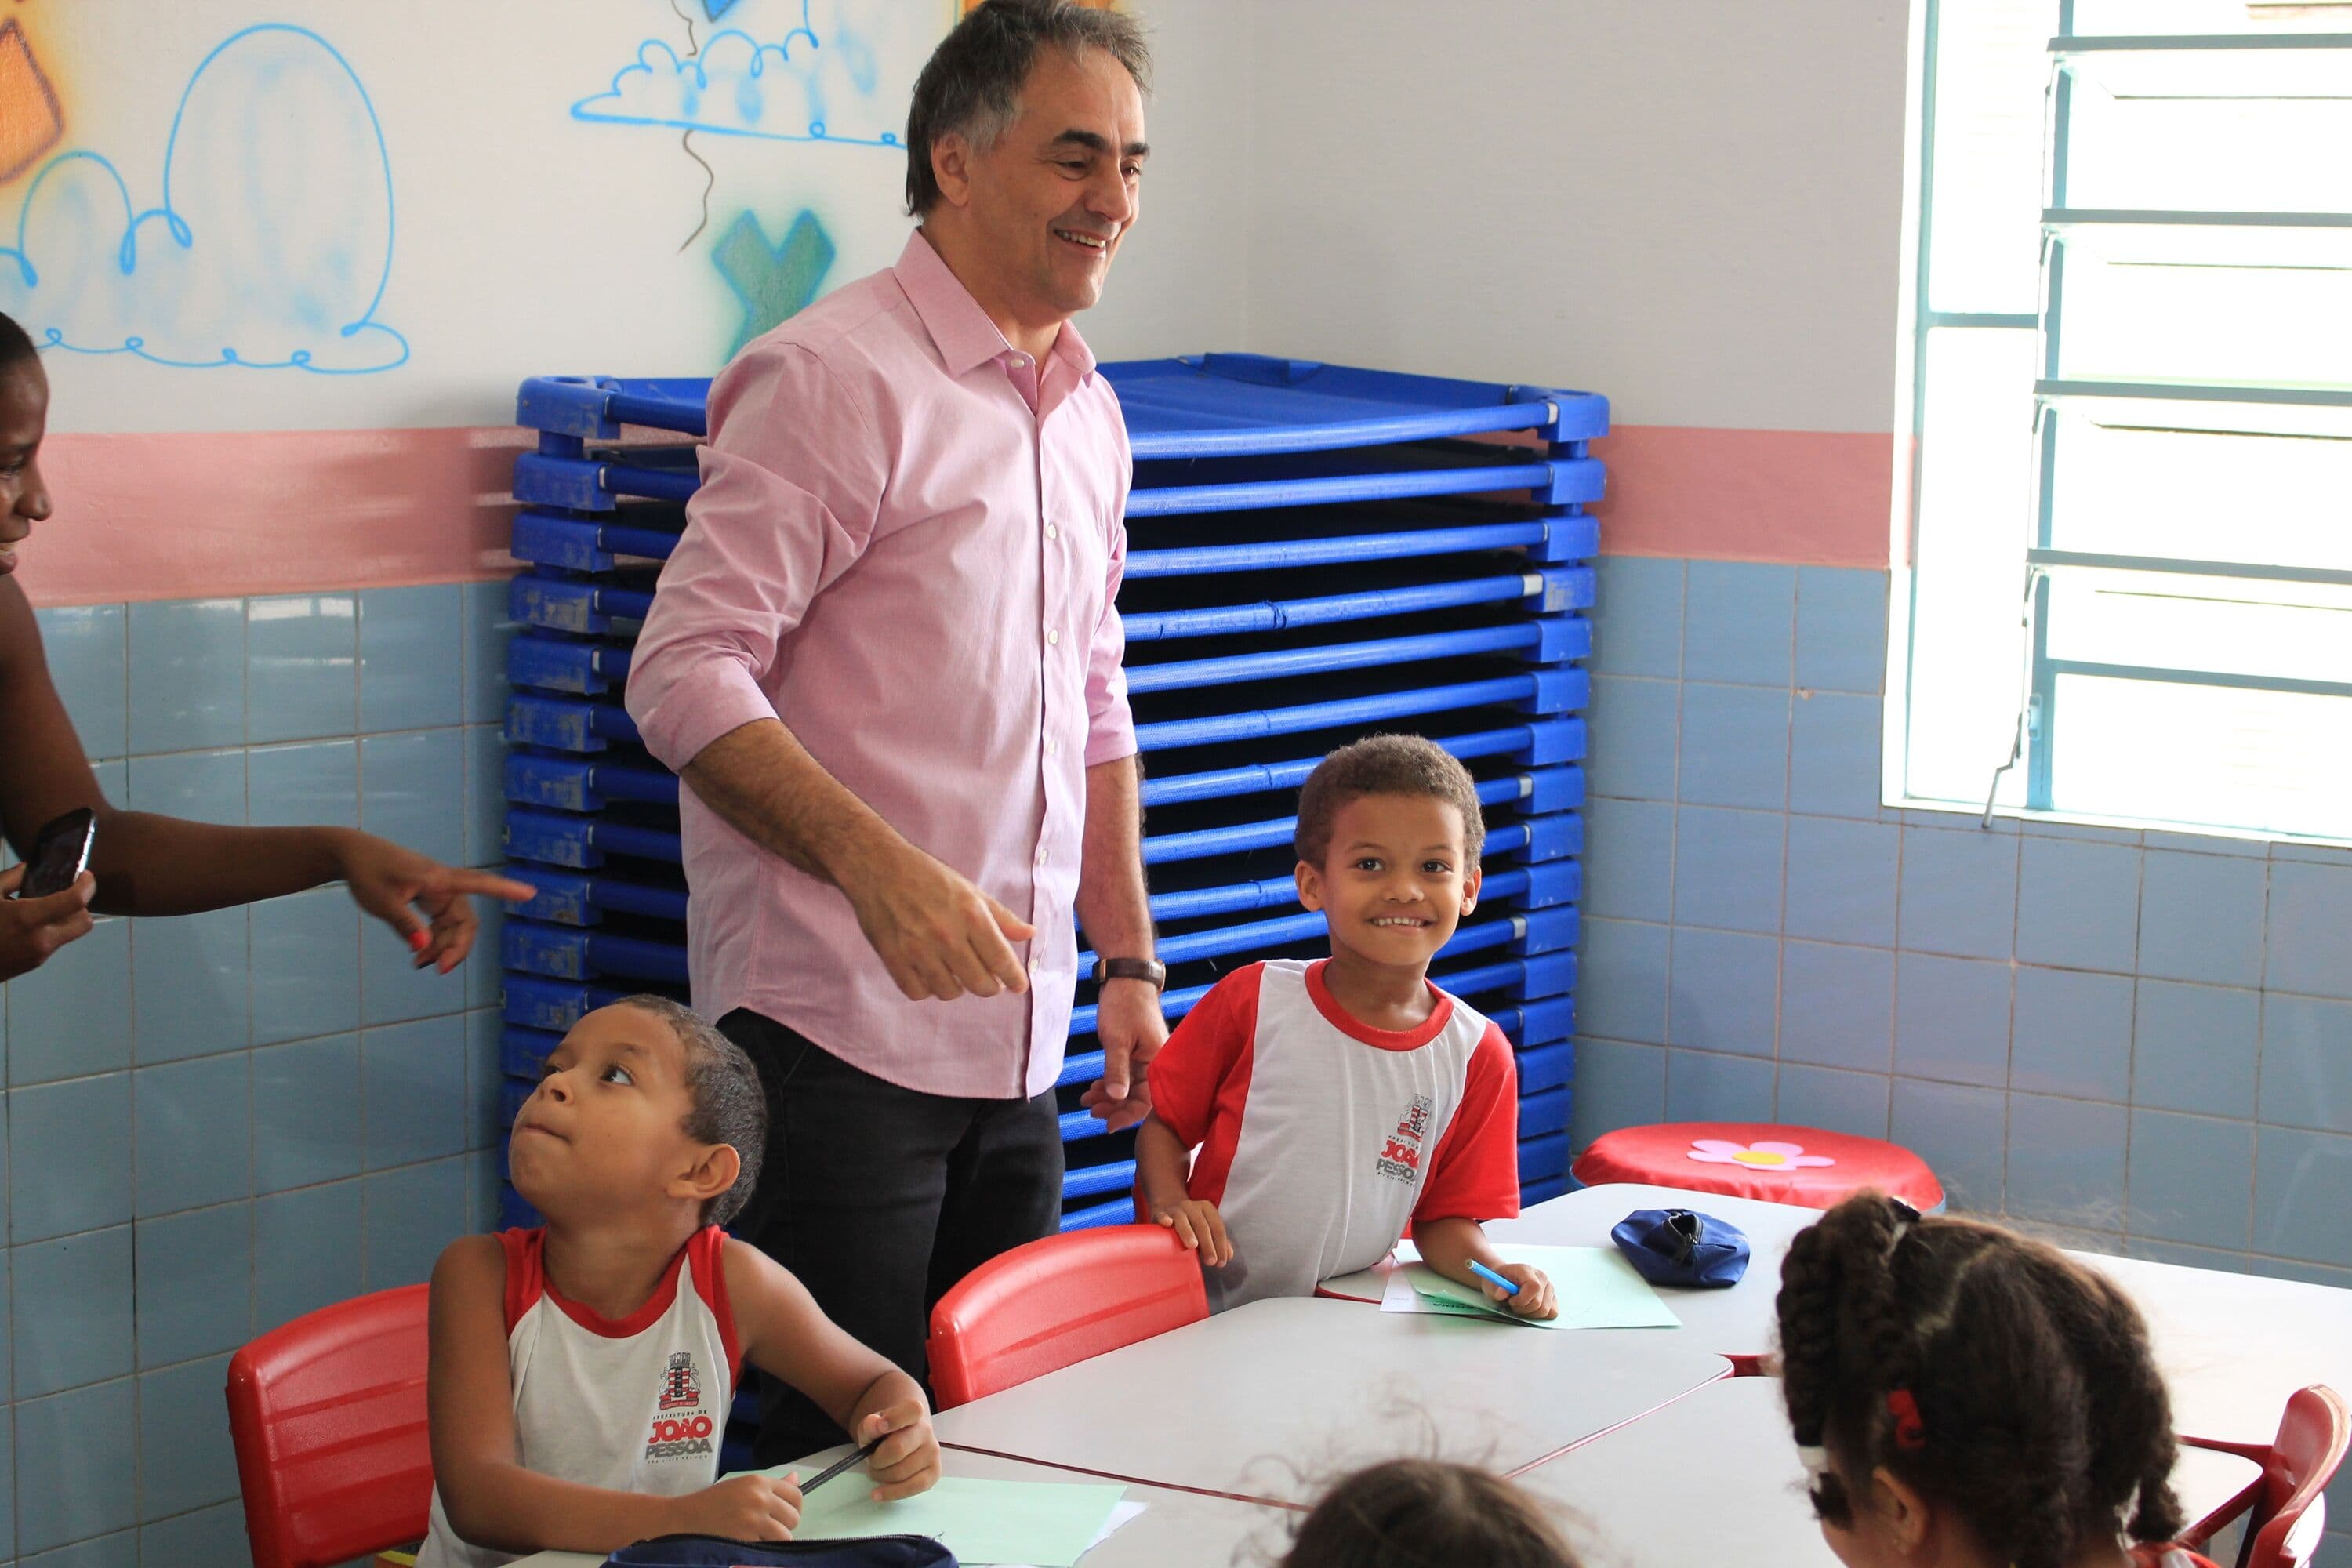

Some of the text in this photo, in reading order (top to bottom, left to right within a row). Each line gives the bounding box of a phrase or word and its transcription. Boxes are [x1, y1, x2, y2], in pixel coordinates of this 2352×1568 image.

[1381, 1139, 1419, 1169] JOÃ
[653, 1411, 694, 1420] PREFEITURA
[648, 1415, 713, 1443] JOÃO
[645, 1439, 713, 1460] PESSOA
